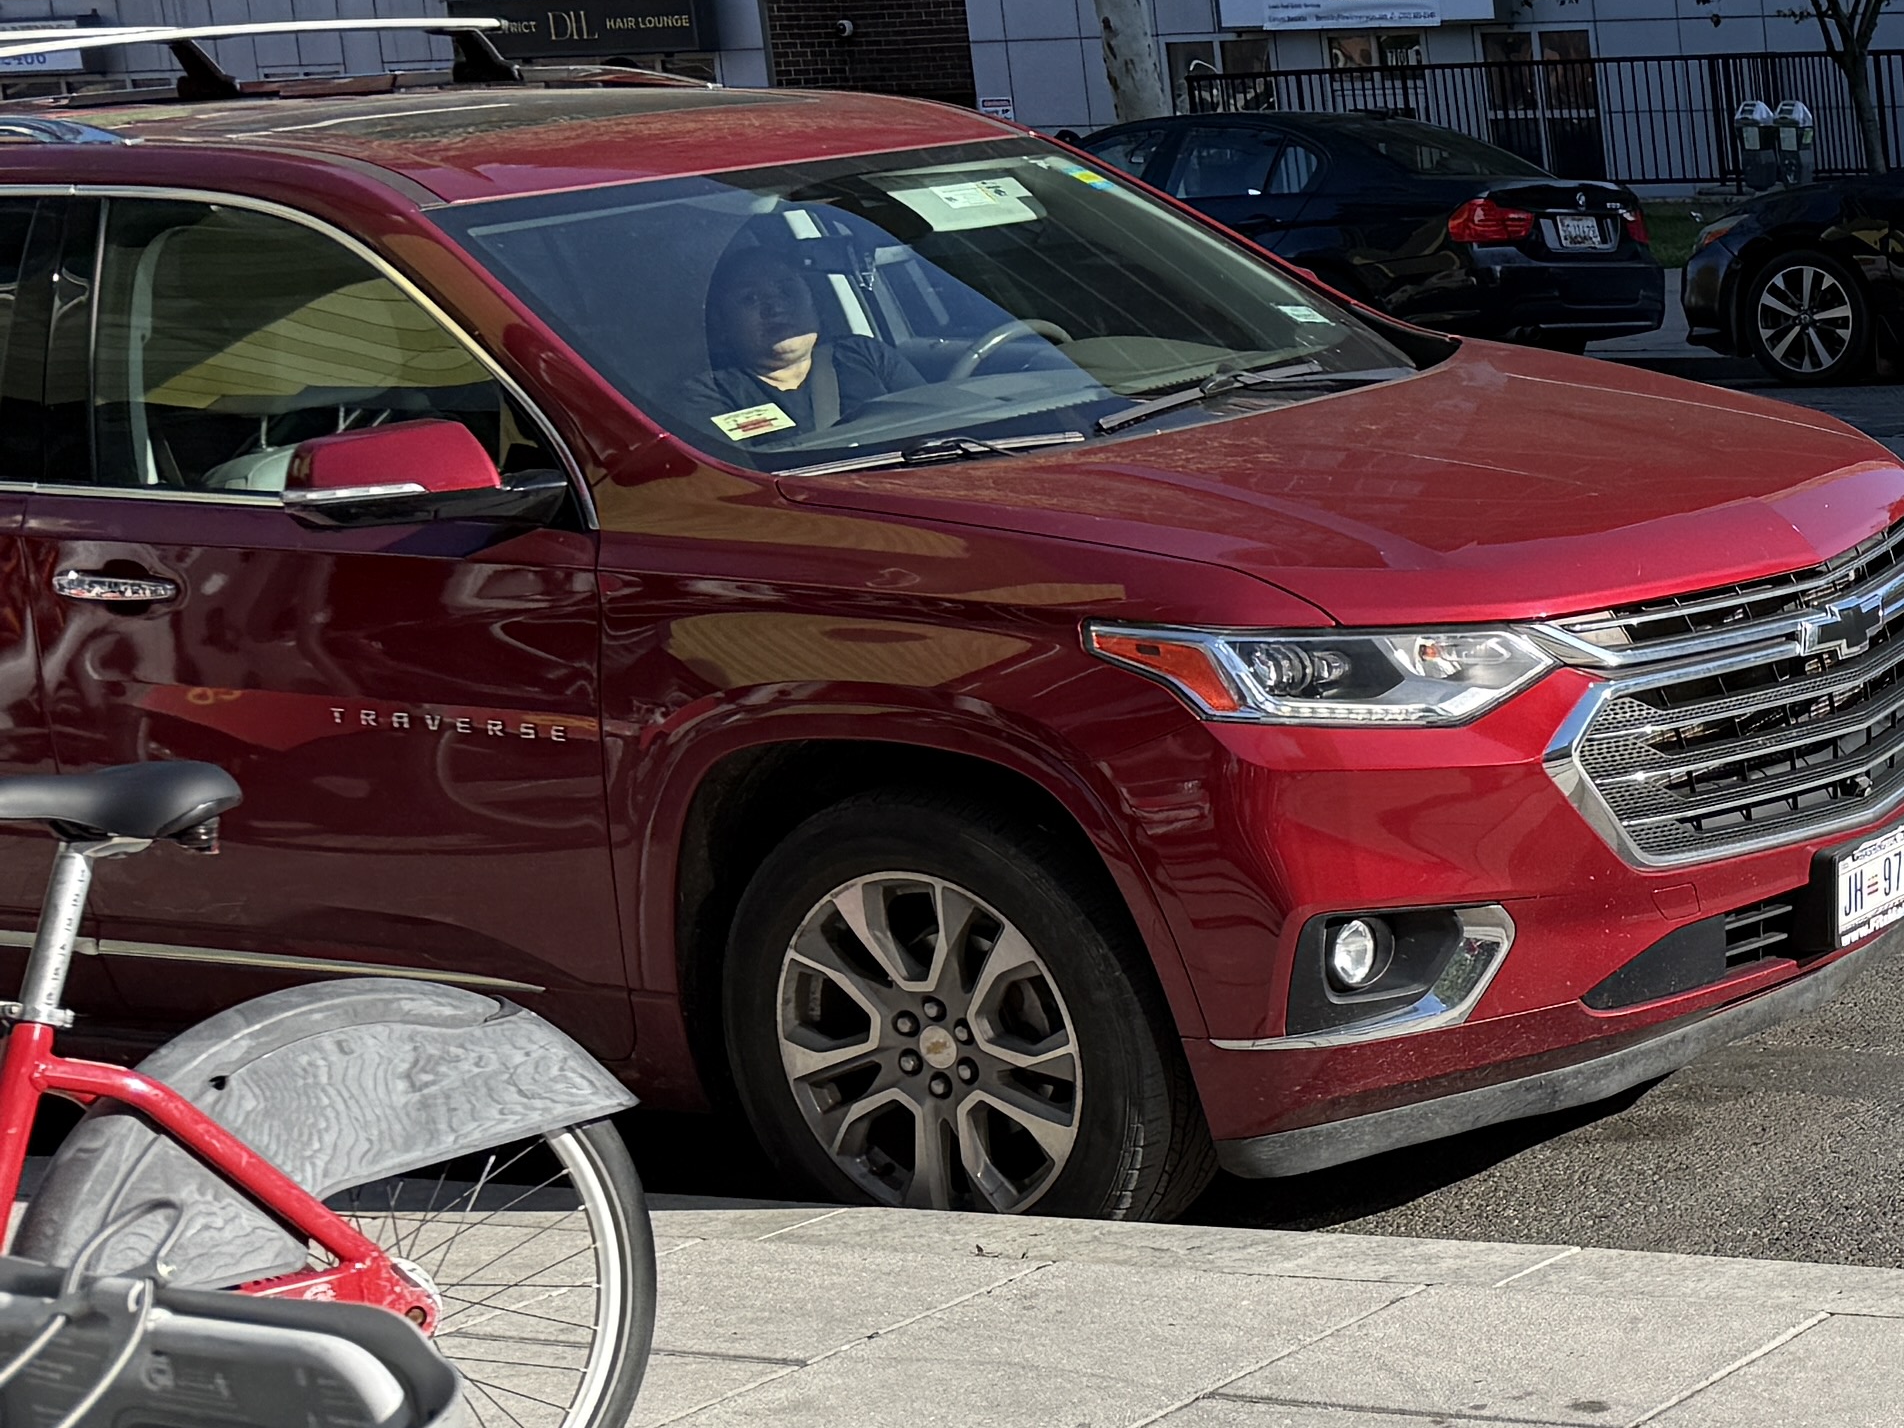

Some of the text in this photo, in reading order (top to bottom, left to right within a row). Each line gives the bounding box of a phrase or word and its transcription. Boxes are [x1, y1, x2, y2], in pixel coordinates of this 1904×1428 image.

[606, 16, 636, 30] HAIR
[638, 14, 690, 29] LOUNGE
[330, 707, 566, 742] TRAVERSE
[1844, 868, 1864, 917] JH
